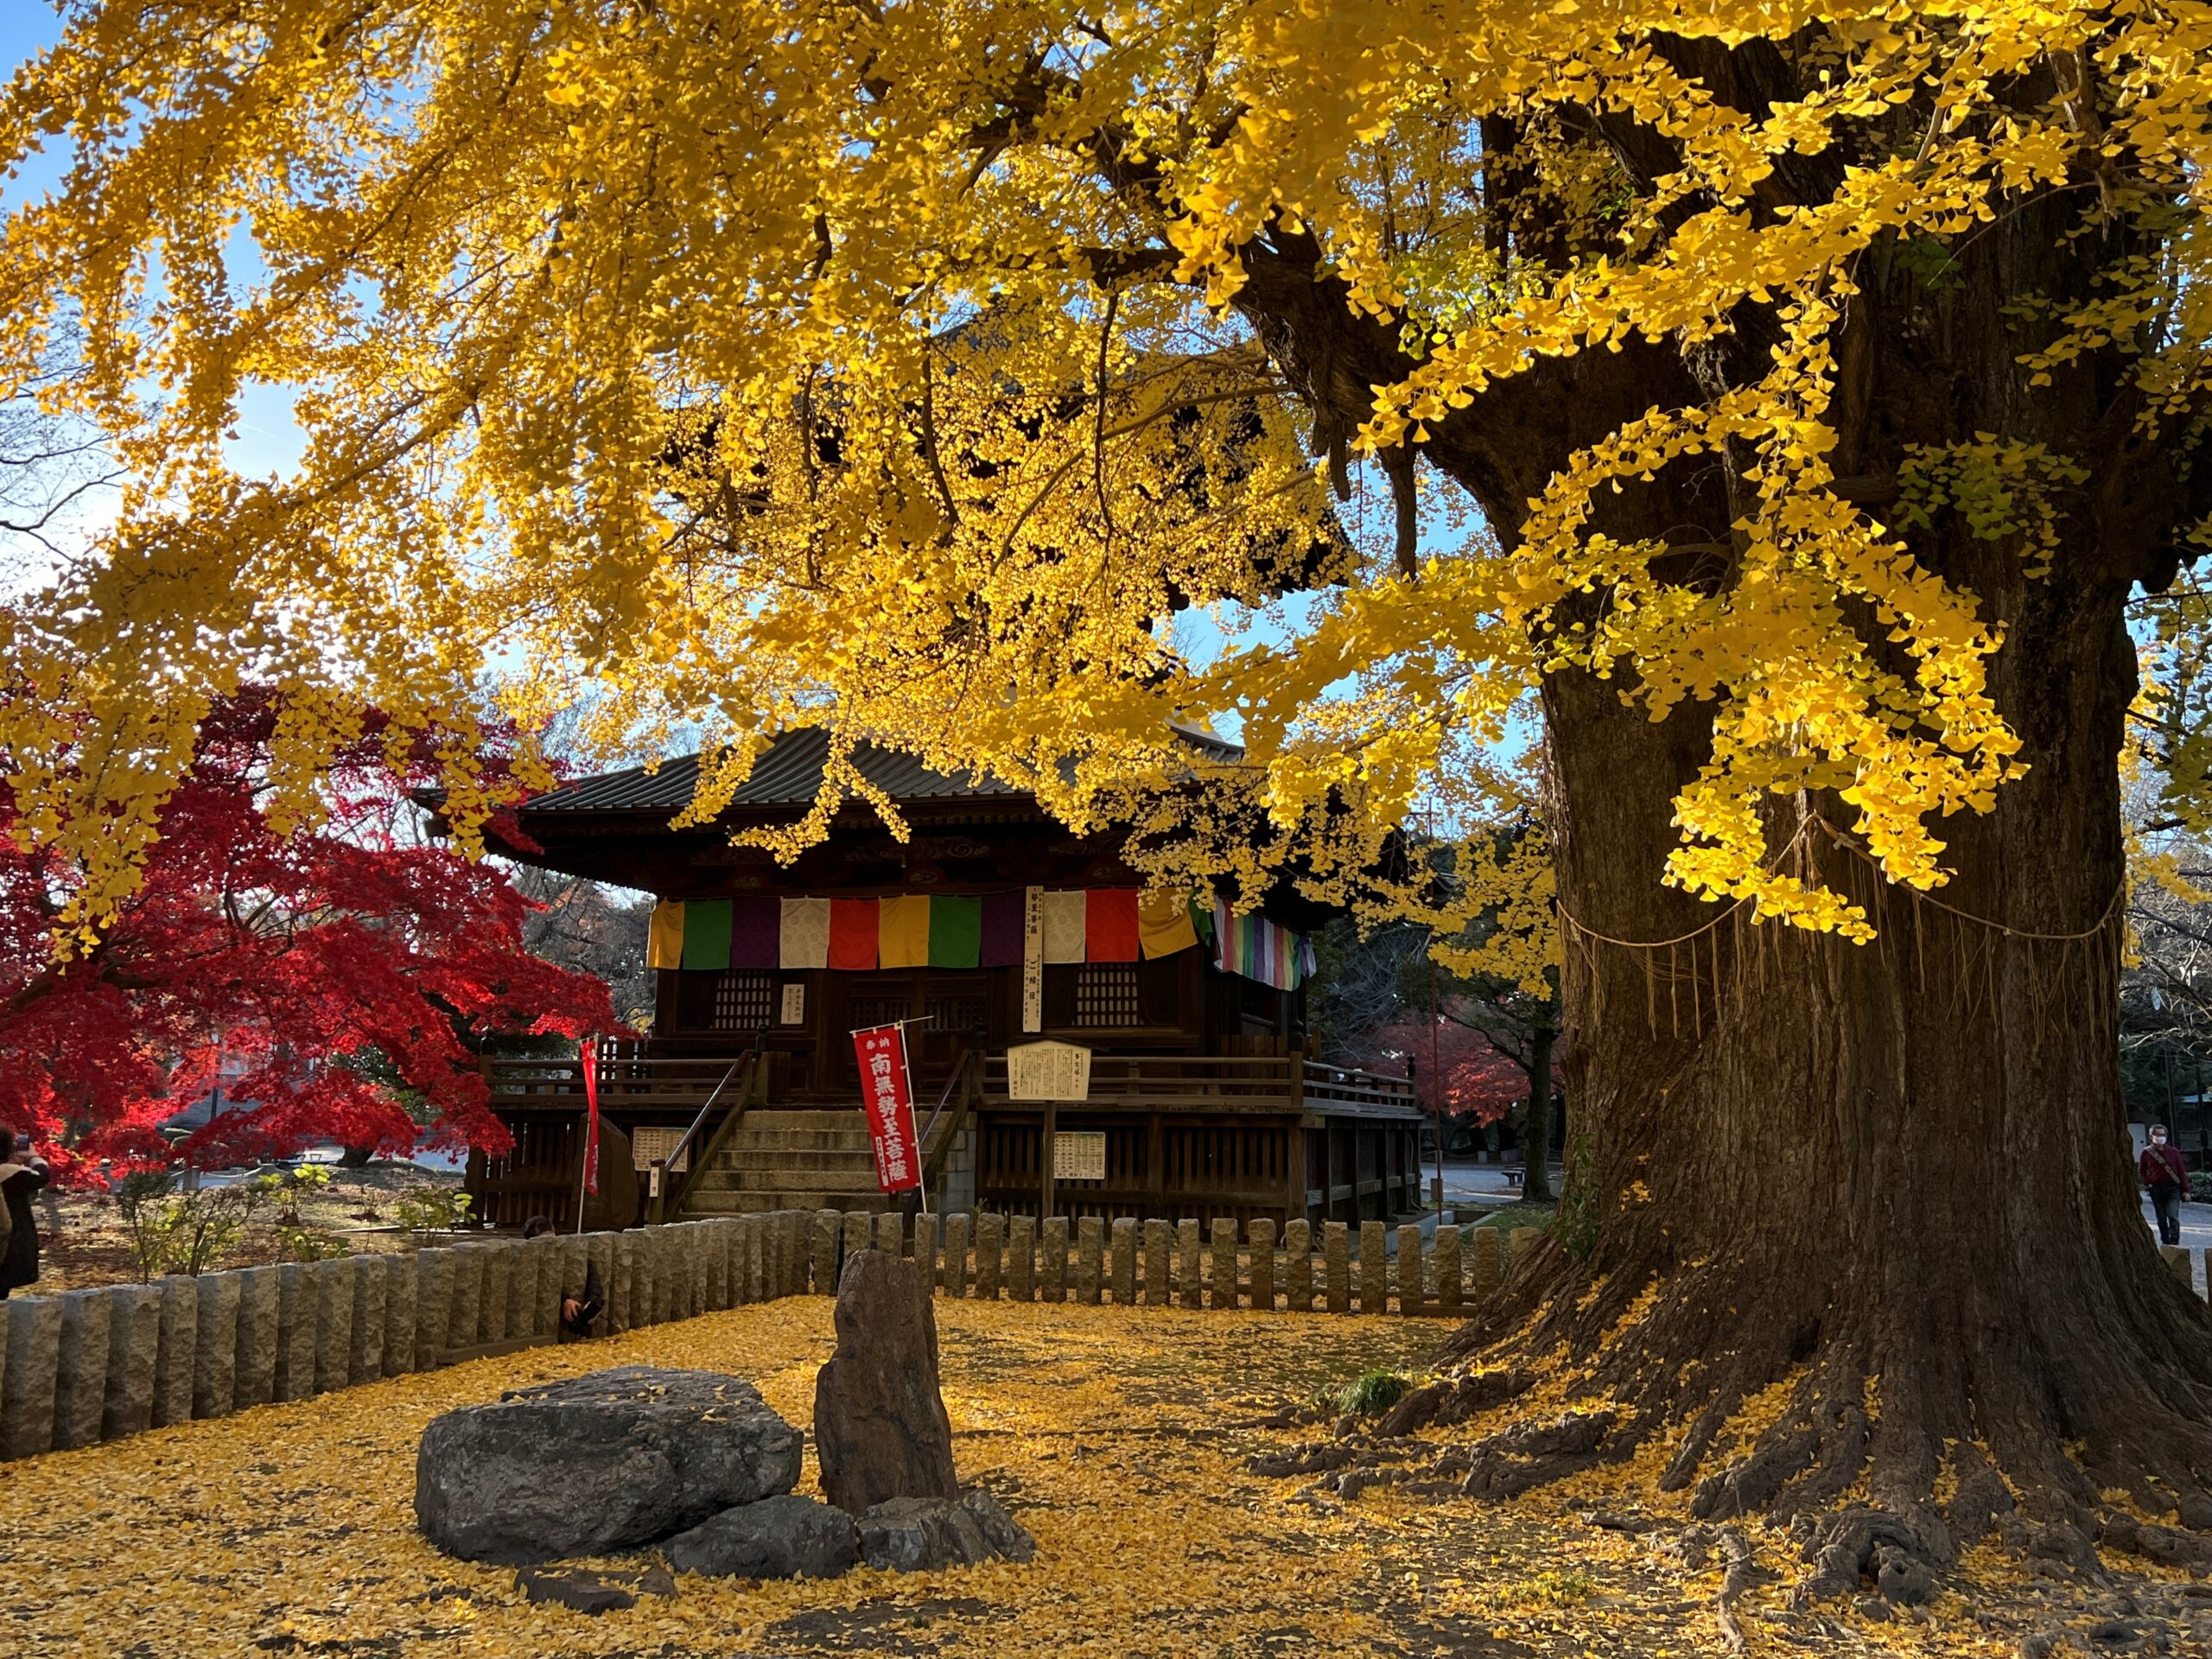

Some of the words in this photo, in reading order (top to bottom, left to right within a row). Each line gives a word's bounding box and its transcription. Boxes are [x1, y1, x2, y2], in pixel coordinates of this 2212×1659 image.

[869, 1052, 908, 1181] 南無勢至菩薩
